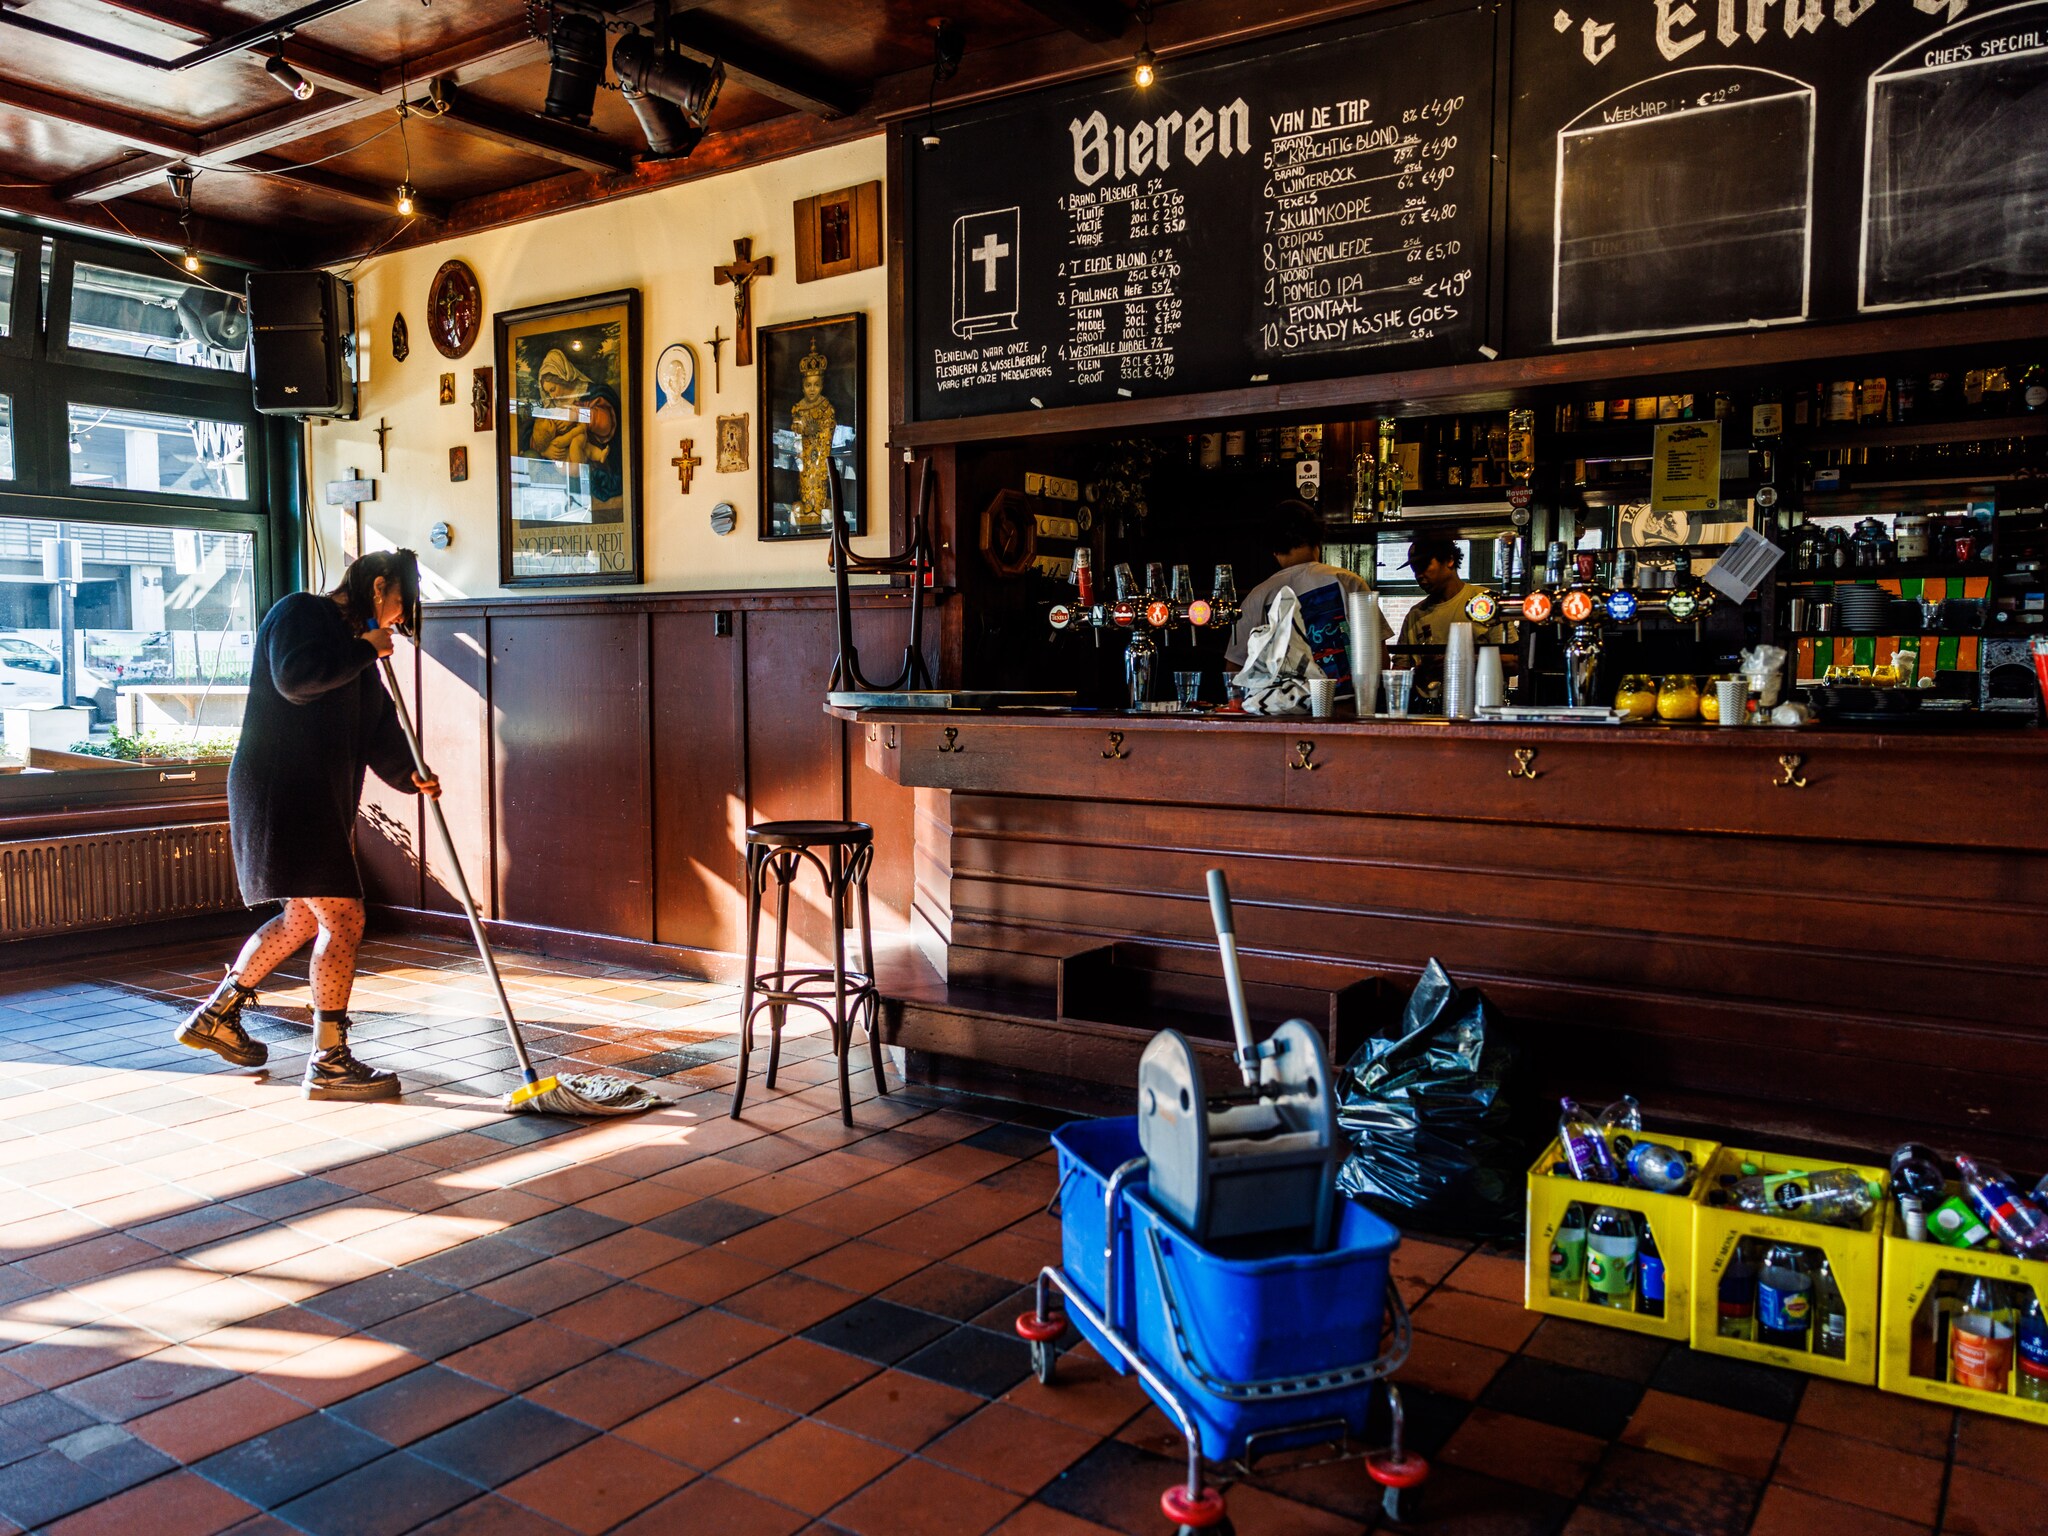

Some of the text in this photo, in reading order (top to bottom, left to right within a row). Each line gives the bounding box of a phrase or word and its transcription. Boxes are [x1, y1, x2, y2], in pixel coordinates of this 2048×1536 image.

[1925, 30, 2048, 67] CHEF'S SPECIAL
[1270, 98, 1371, 134] VAN DE TAP
[1402, 109, 1419, 124] 8%
[1069, 97, 1252, 187] Bieren
[1273, 135, 1314, 155] BRAND
[1288, 137, 1353, 165] KRACHTIG
[1356, 125, 1399, 151] BLOND
[1274, 165, 1306, 182] BRAND
[1282, 166, 1357, 194] WINTERBOCK
[1398, 174, 1414, 190] 6%
[1069, 193, 1096, 208] BRAND
[1100, 183, 1138, 202] PILSENER
[1147, 178, 1162, 195] 5%
[1278, 191, 1318, 211] TEXELS
[1278, 197, 1372, 231] SKUUMKOPPE
[1400, 213, 1415, 226] 6%
[1085, 255, 1113, 273] ELFDE
[1116, 251, 1147, 270] BLOND
[1280, 237, 1374, 269] MANNENLIEFDE
[1407, 249, 1421, 262] 6%
[1279, 267, 1315, 285] NOORDT
[1071, 287, 1119, 305] PAULANER
[1124, 285, 1143, 297] HEFE
[1283, 279, 1331, 304] POMELO
[1337, 273, 1363, 295] IPA
[1289, 297, 1363, 324] FRONTAAL
[1284, 319, 1348, 348] STEADY
[1408, 305, 1459, 327] GOES
[934, 341, 1029, 364] BENIEUWD NAAR ONZE
[1069, 342, 1115, 358] WESTMALLE
[1118, 339, 1148, 352] DUBBEL
[1150, 337, 1164, 348] 7%
[936, 362, 978, 379] FLESBIEREN
[980, 361, 989, 373] &
[936, 366, 1053, 392] VRAAG HET ONZE MEDEWERKERS
[1506, 489, 1532, 497] Havana
[1511, 496, 1527, 504] Club
[519, 533, 623, 554] MOEDERMELK REDT
